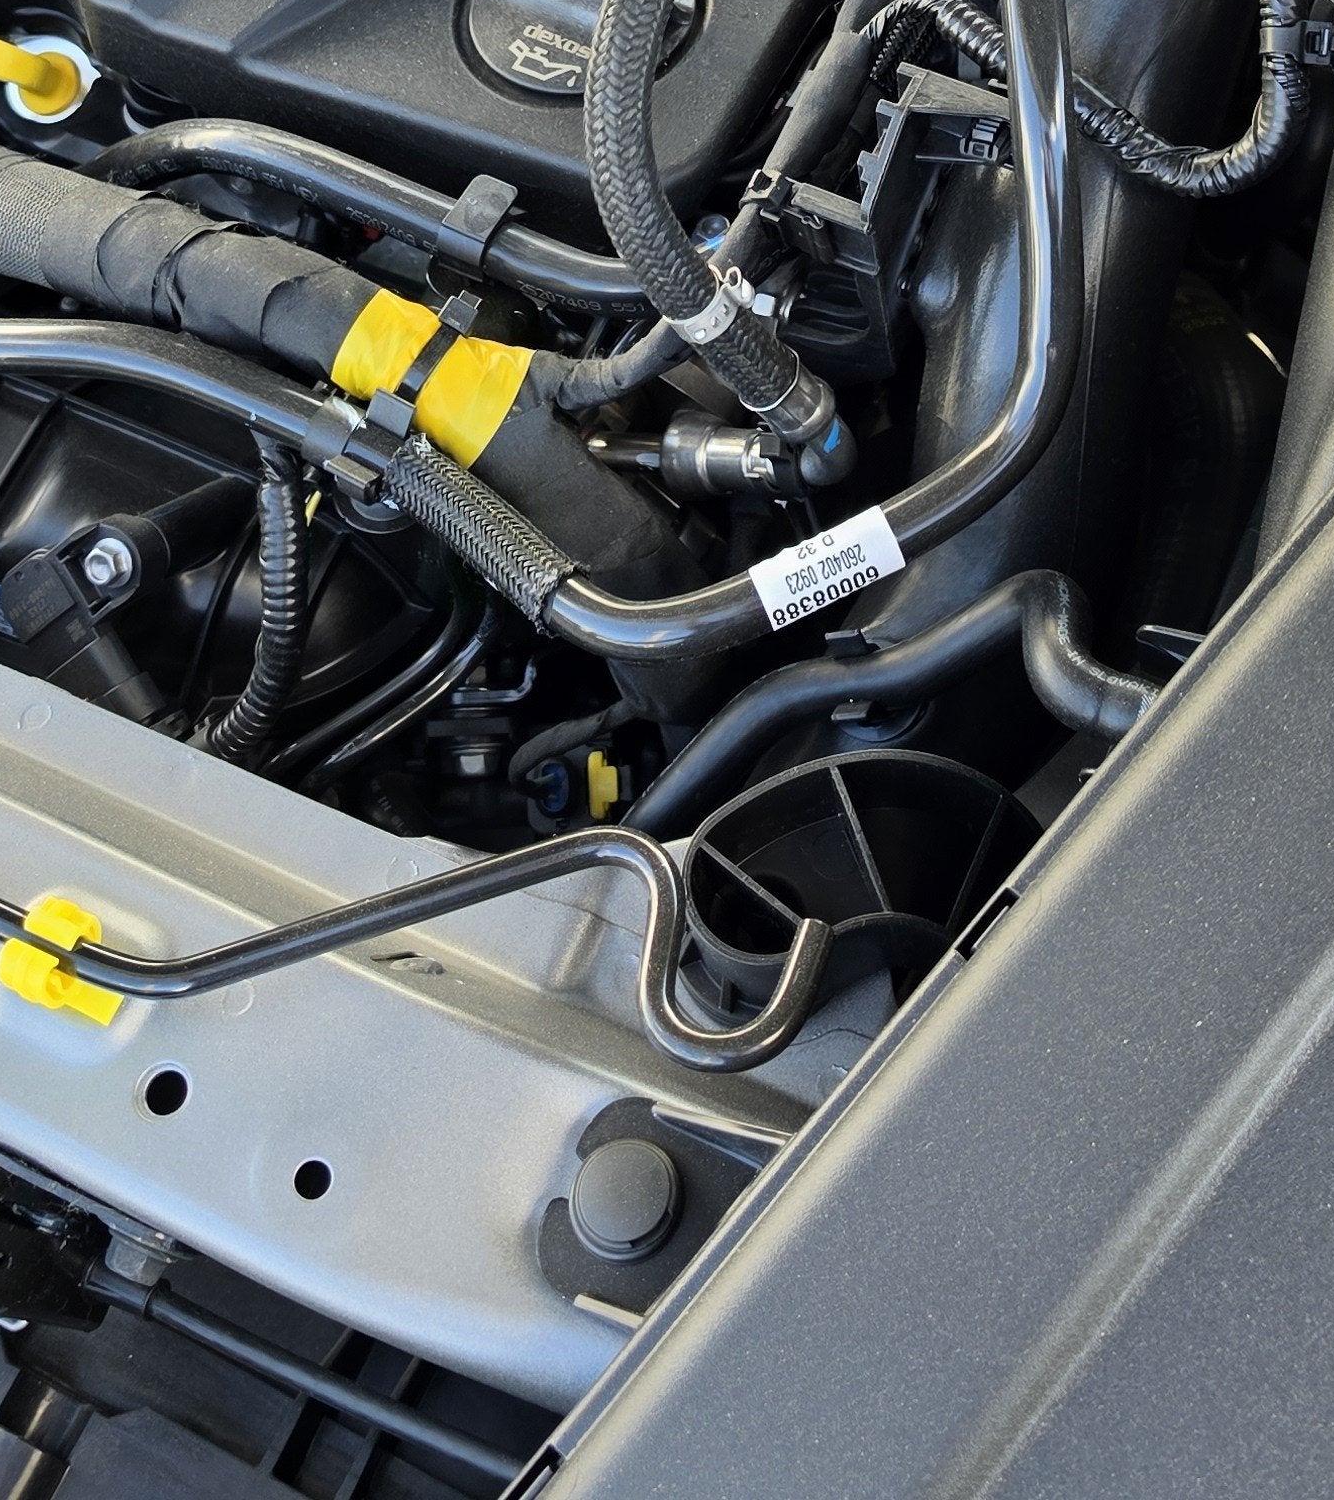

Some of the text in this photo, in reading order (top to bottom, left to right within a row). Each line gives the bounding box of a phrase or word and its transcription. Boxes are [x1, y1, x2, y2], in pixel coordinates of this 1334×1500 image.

[794, 534, 834, 560] D 32
[784, 543, 867, 595] 260402 0923
[770, 564, 880, 626] 60008388
[1089, 665, 1160, 700] SLOVAKI
